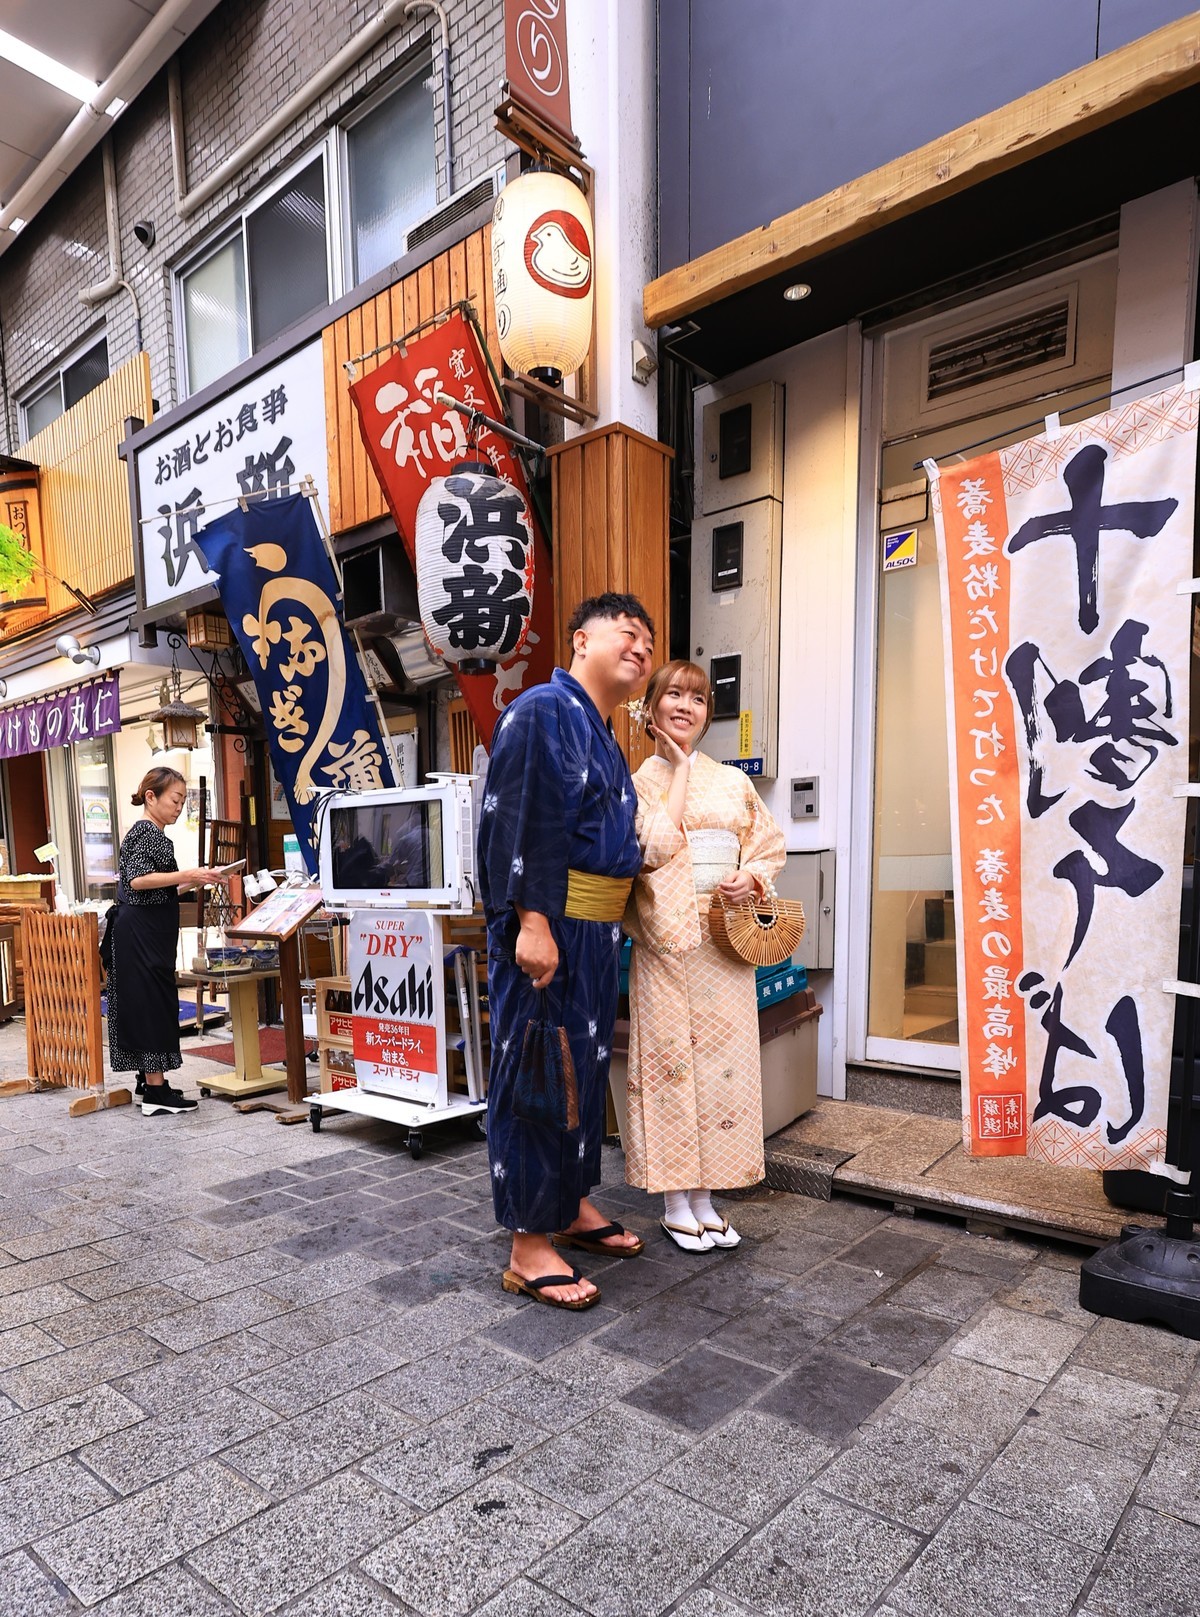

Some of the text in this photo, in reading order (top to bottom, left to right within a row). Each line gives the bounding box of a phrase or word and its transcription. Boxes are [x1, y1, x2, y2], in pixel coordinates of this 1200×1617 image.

[154, 383, 289, 486] お酒とお食事
[886, 557, 914, 568] ALSOK
[0, 688, 113, 752] けもの丸仁
[740, 762, 759, 771] 19-8
[375, 920, 405, 931] SUPER
[360, 933, 423, 958] "DRY"
[354, 960, 433, 1020] Asahi
[757, 976, 794, 999] 長青果
[379, 1022, 410, 1035] 発売36年目
[366, 1031, 424, 1054] 新スーパードライ、
[382, 1048, 409, 1067] 始まる。
[373, 1063, 421, 1083] スーパードライ
